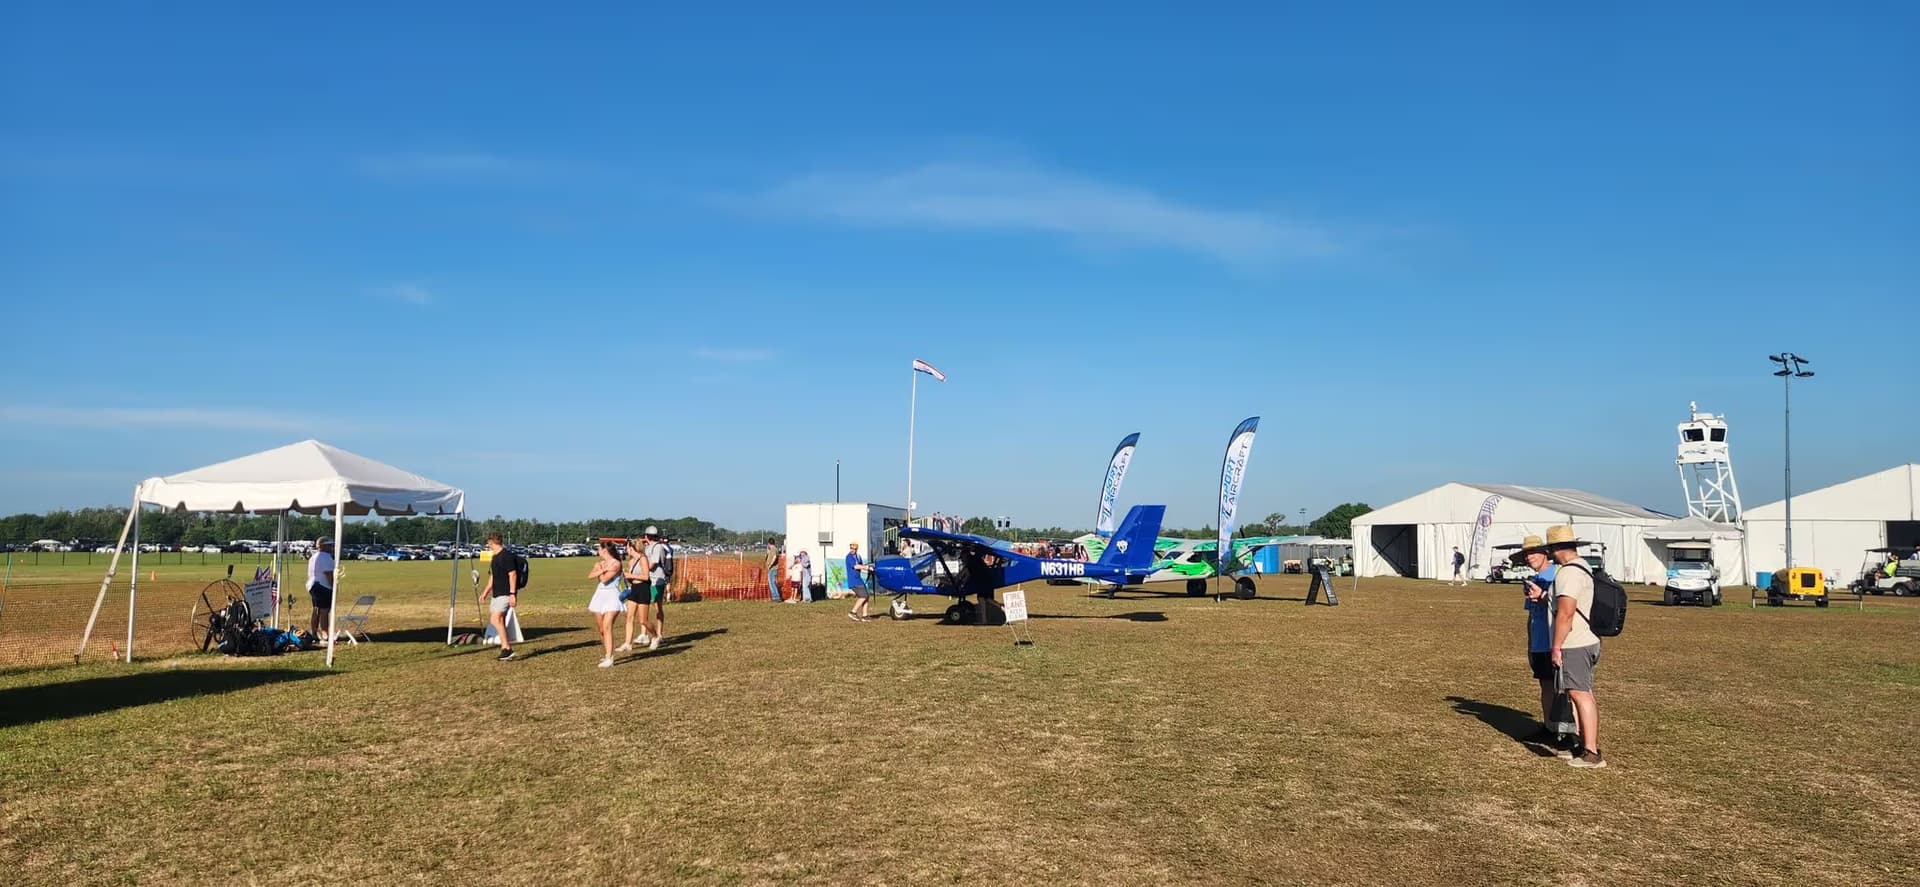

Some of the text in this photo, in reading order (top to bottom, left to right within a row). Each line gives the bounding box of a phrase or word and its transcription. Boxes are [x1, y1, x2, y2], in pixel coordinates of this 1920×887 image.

[1223, 457, 1236, 502] SPORT
[1229, 443, 1248, 505] AIRCRAFT
[1041, 561, 1085, 576] N631HB
[1006, 599, 1025, 609] LANE
